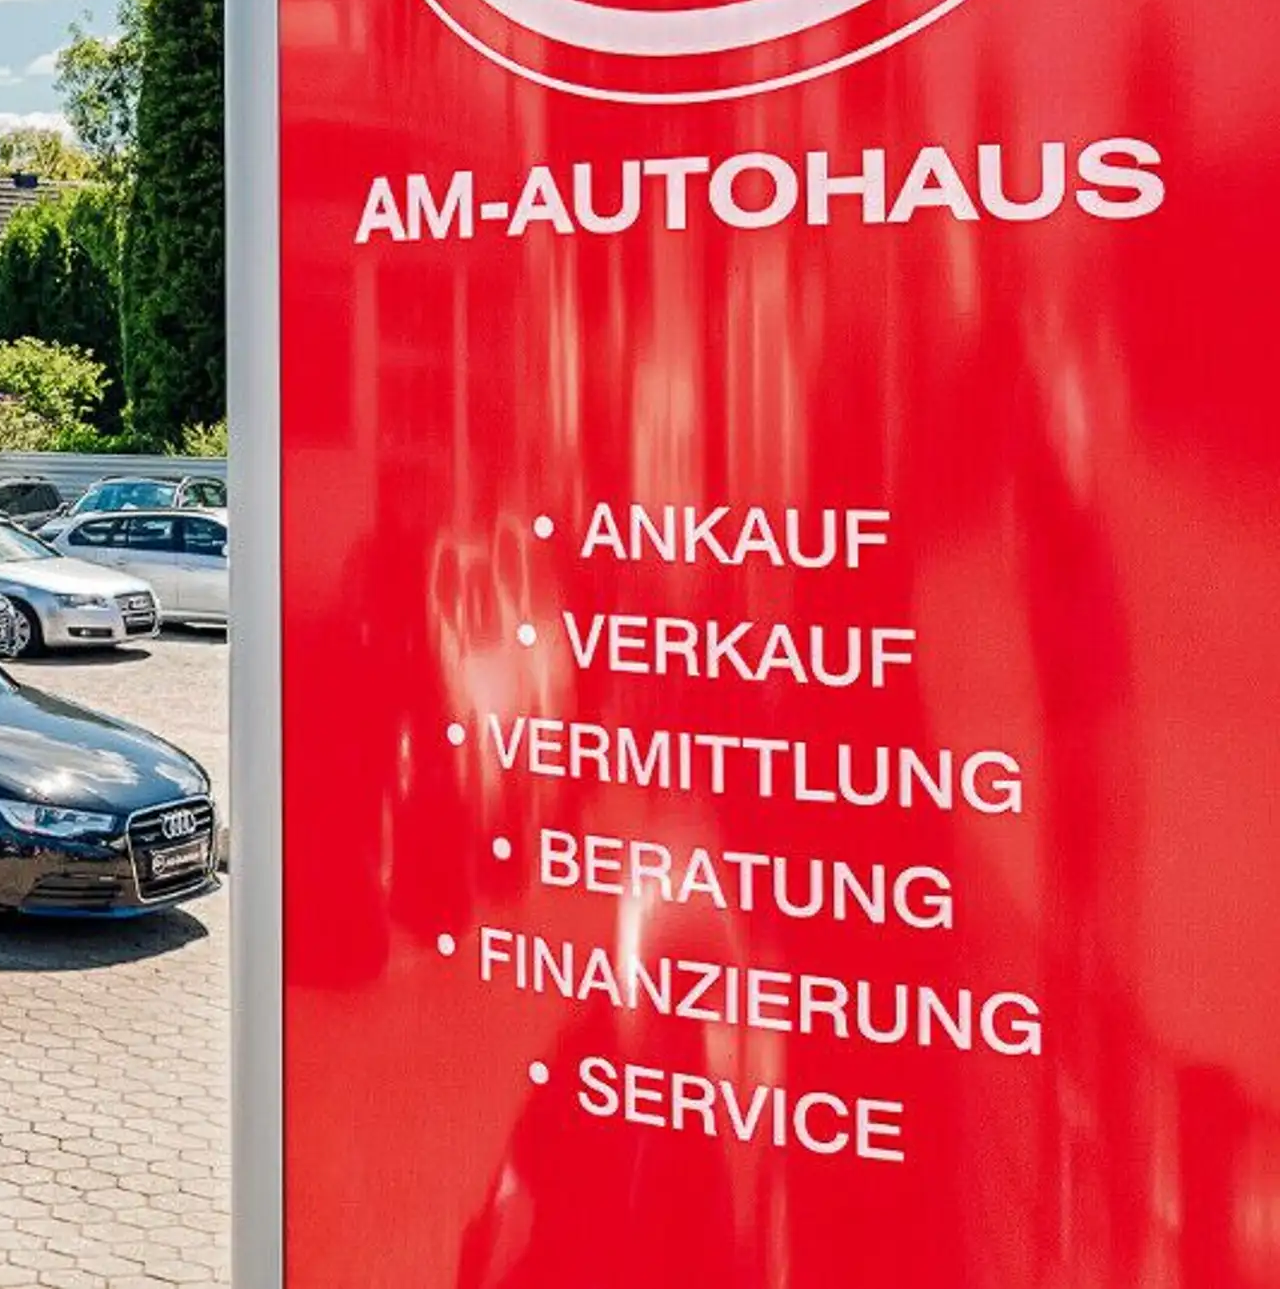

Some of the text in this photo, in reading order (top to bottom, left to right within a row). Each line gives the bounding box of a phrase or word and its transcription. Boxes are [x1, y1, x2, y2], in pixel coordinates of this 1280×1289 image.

[354, 137, 1165, 243] AM-AUTOHAUS
[580, 501, 890, 568] ANKAUF
[563, 610, 917, 687] VERKAUF
[489, 713, 1024, 813] VERMITTLUNG
[539, 828, 954, 930] BERATUNG
[479, 926, 1042, 1056] FINANZIERUNG
[576, 1056, 906, 1162] SERVICE
